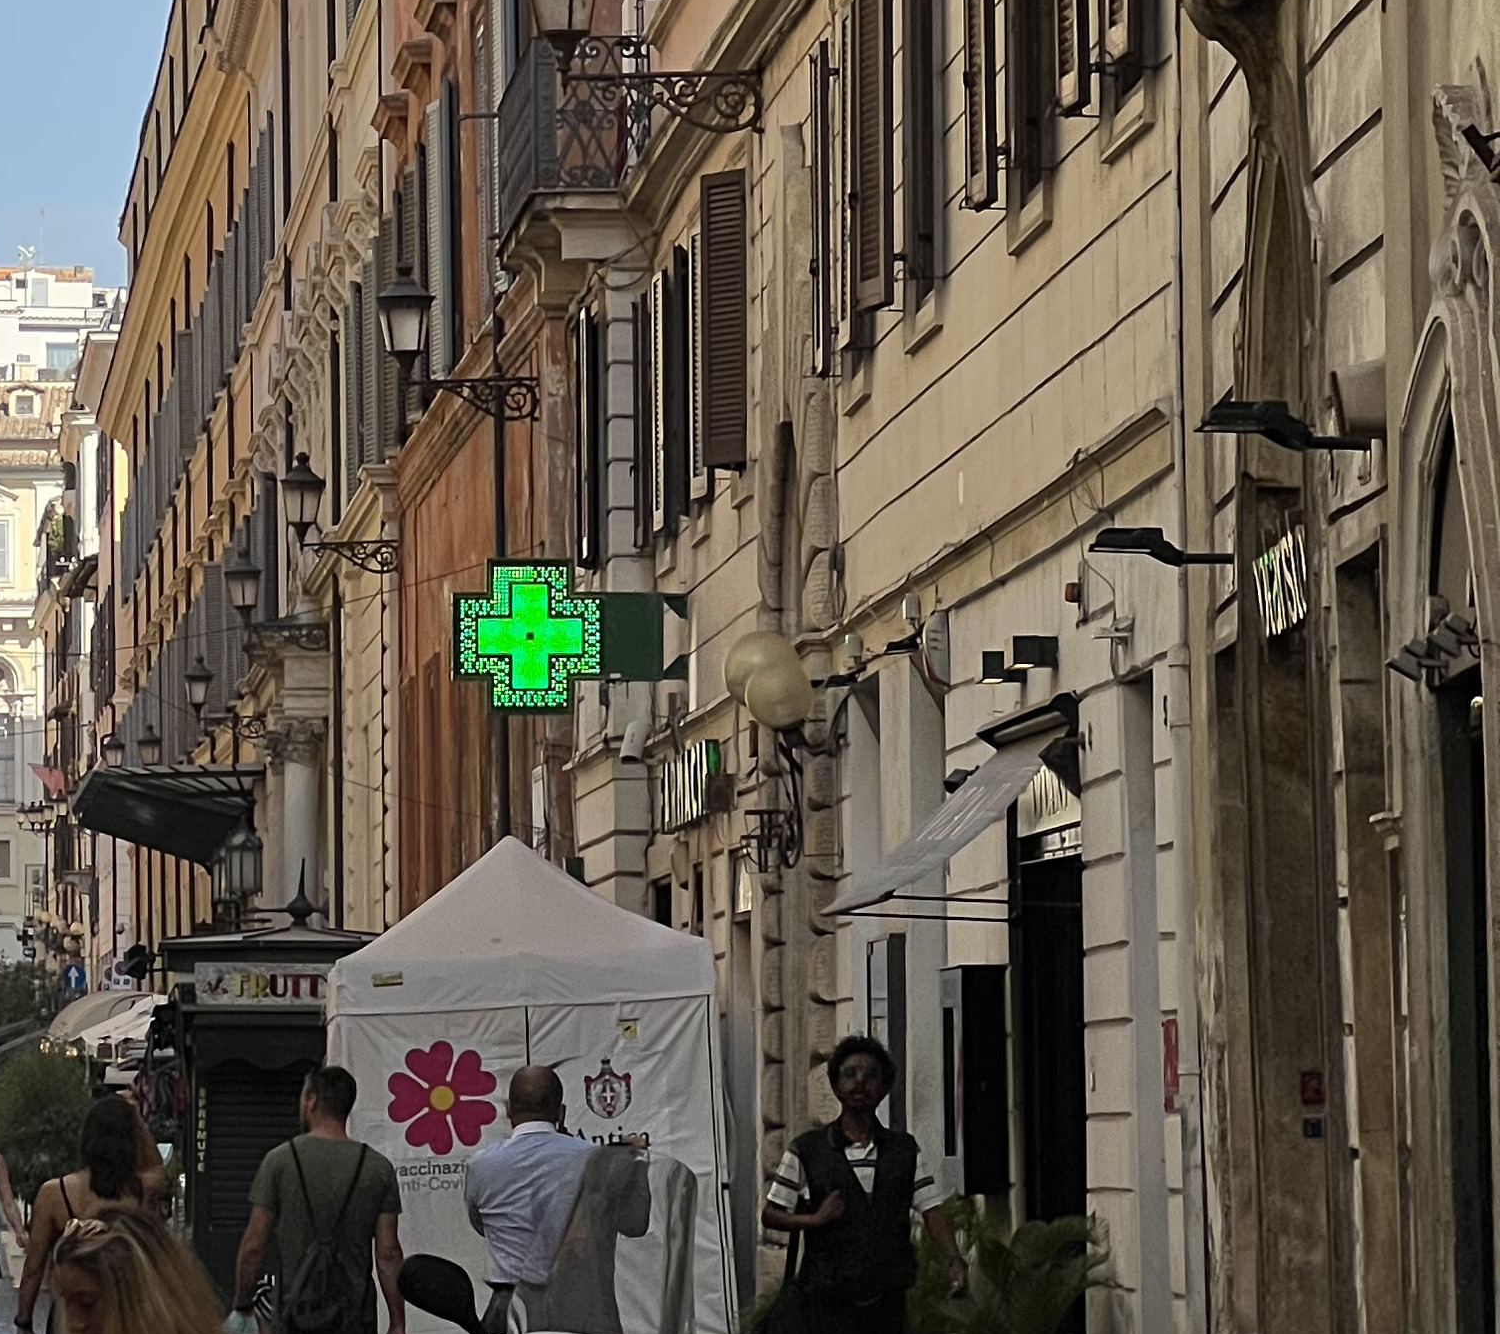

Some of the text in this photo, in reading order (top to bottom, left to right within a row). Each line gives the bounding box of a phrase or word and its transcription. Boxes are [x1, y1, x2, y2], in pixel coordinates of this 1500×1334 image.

[234, 970, 328, 999] FRUTT
[393, 1160, 467, 1178] accinazi
[400, 1176, 465, 1193] nti-Covi
